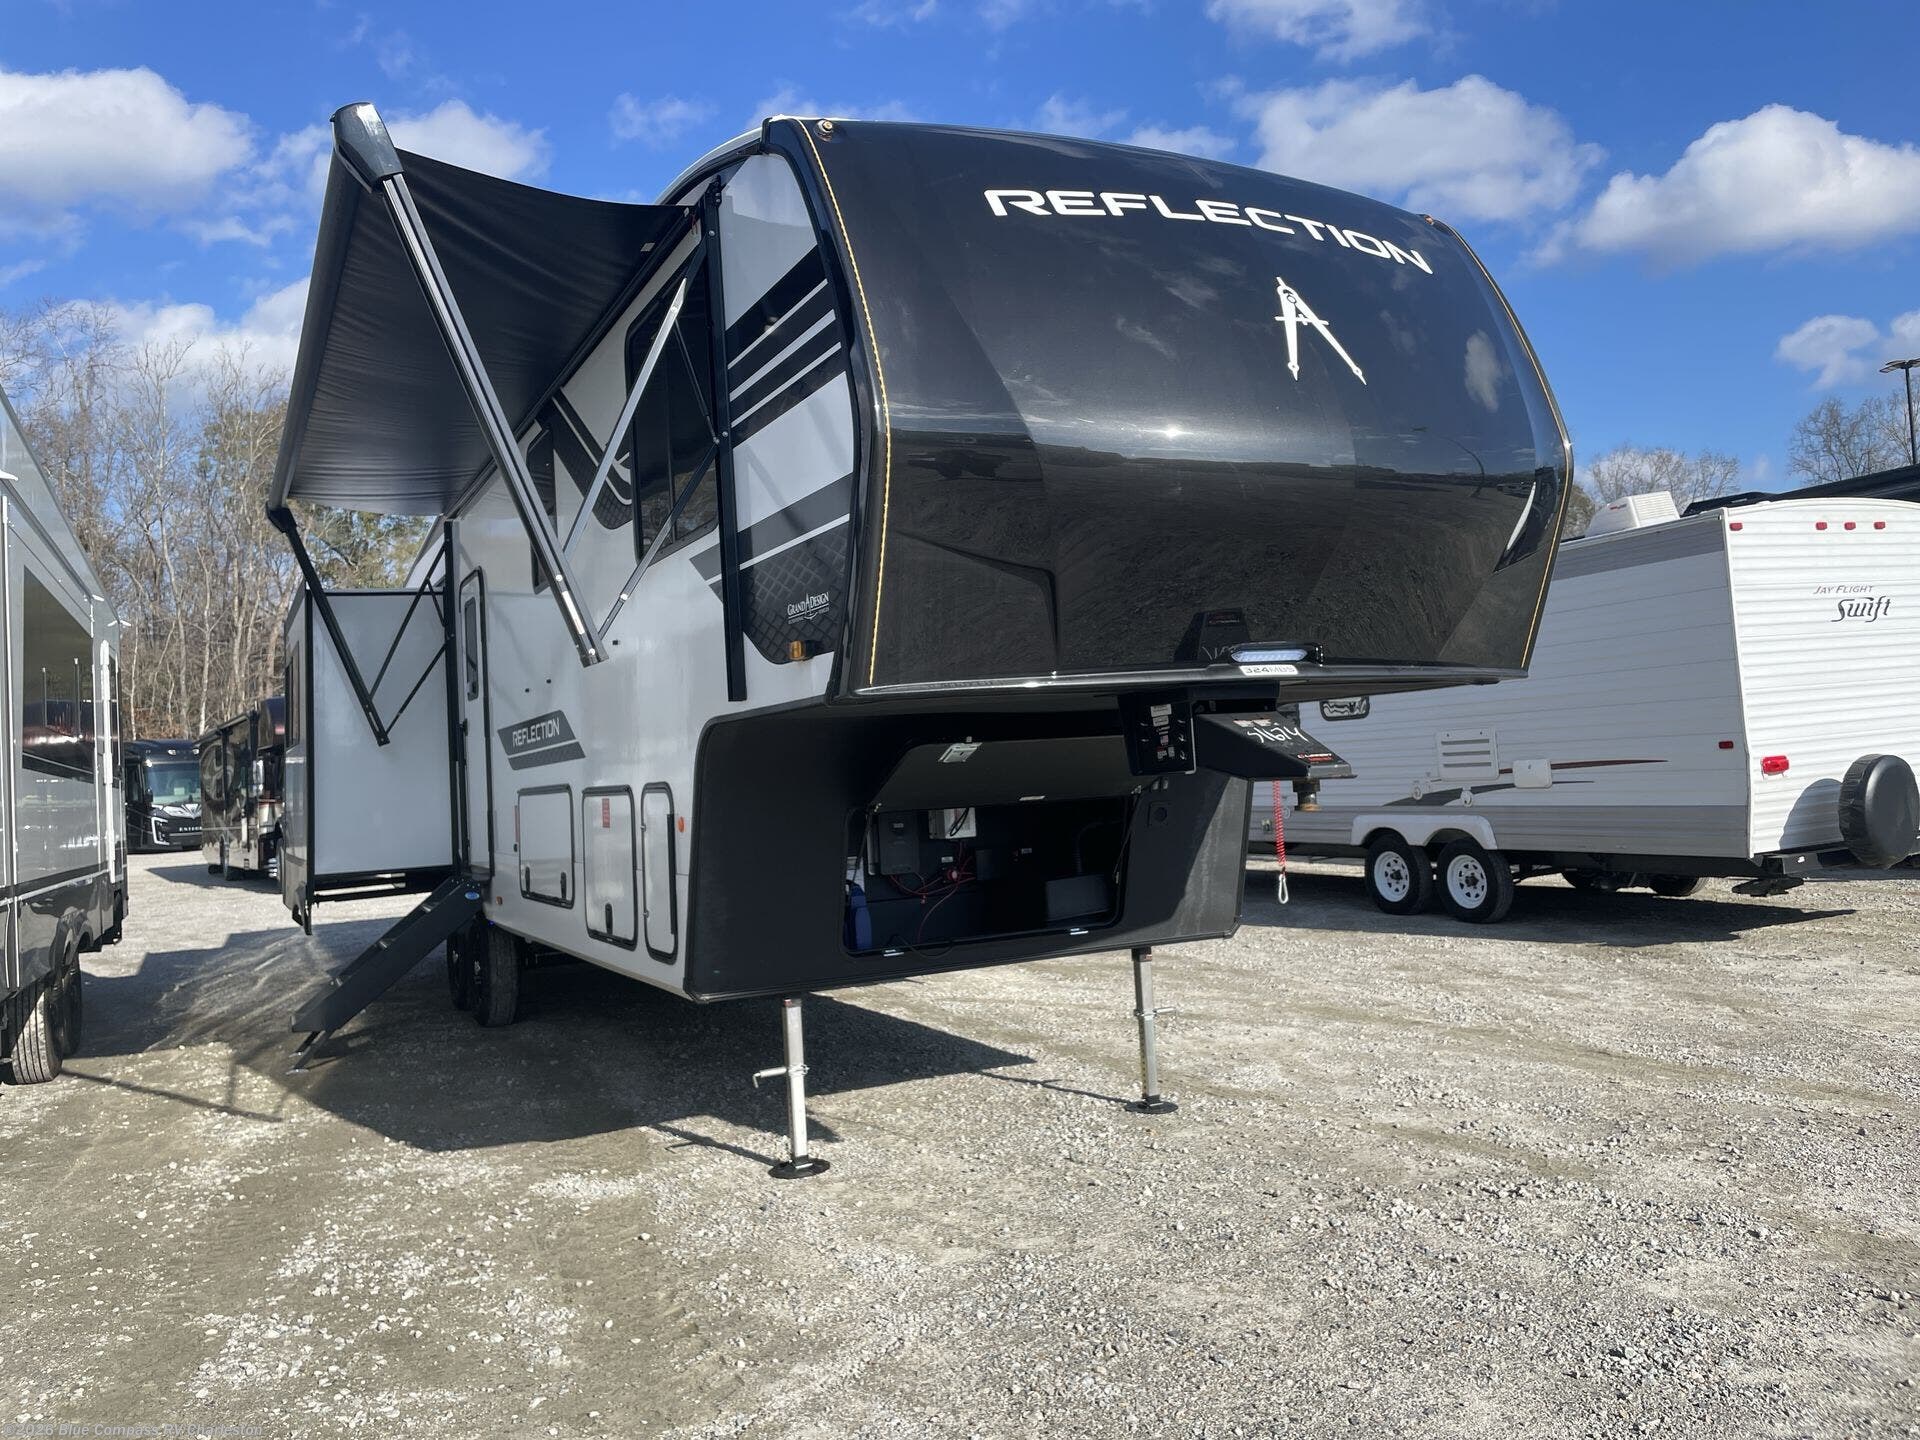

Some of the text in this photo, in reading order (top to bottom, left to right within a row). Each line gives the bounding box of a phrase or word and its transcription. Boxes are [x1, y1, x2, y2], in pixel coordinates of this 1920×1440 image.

[983, 189, 1434, 275] REFLECTION
[787, 601, 806, 616] GRAND
[809, 592, 830, 609] DESIGN
[1813, 585, 1874, 595] JAY FLIGHT
[1830, 595, 1891, 623] Swift
[512, 716, 560, 748] REFLECTION
